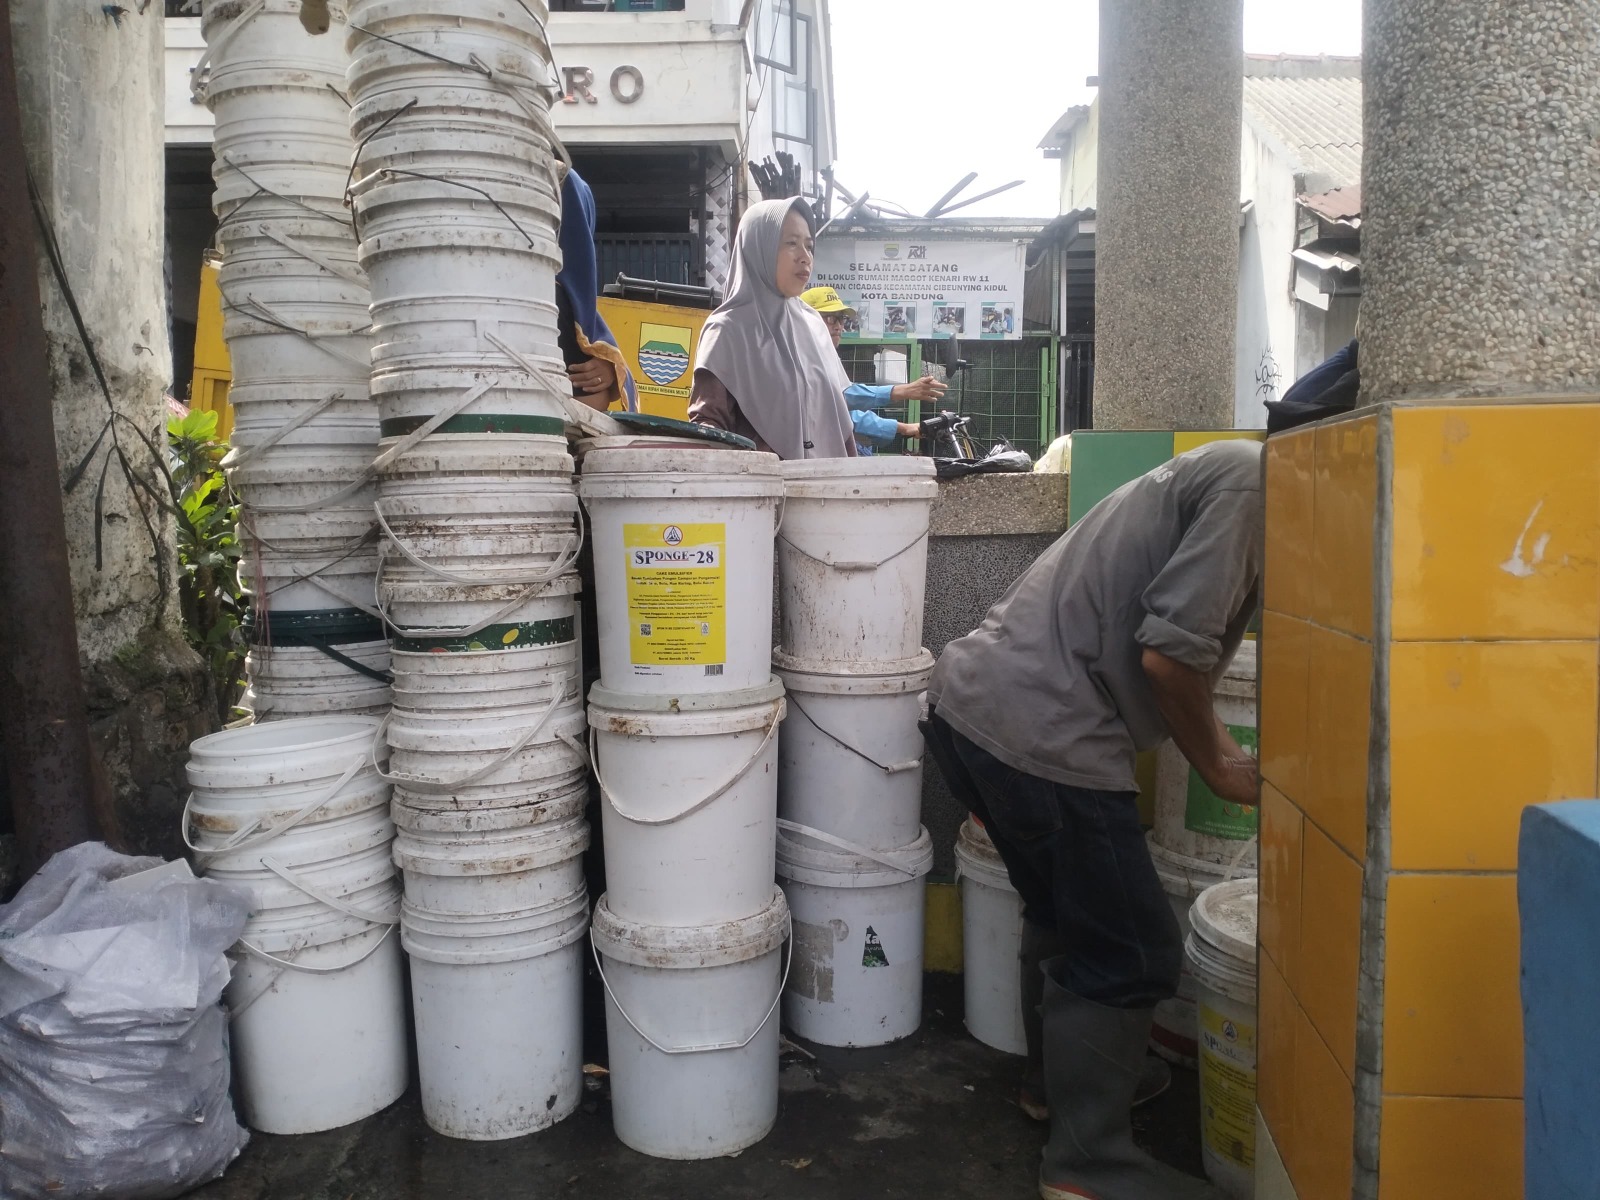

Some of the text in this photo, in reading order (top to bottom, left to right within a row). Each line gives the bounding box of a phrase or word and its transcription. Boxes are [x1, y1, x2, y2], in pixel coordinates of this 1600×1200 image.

[849, 263, 959, 273] SELAMAT DATANG
[891, 274, 927, 282] MAGGOT
[984, 284, 1008, 292] KIDUL
[635, 550, 714, 565] SPONGE-28
